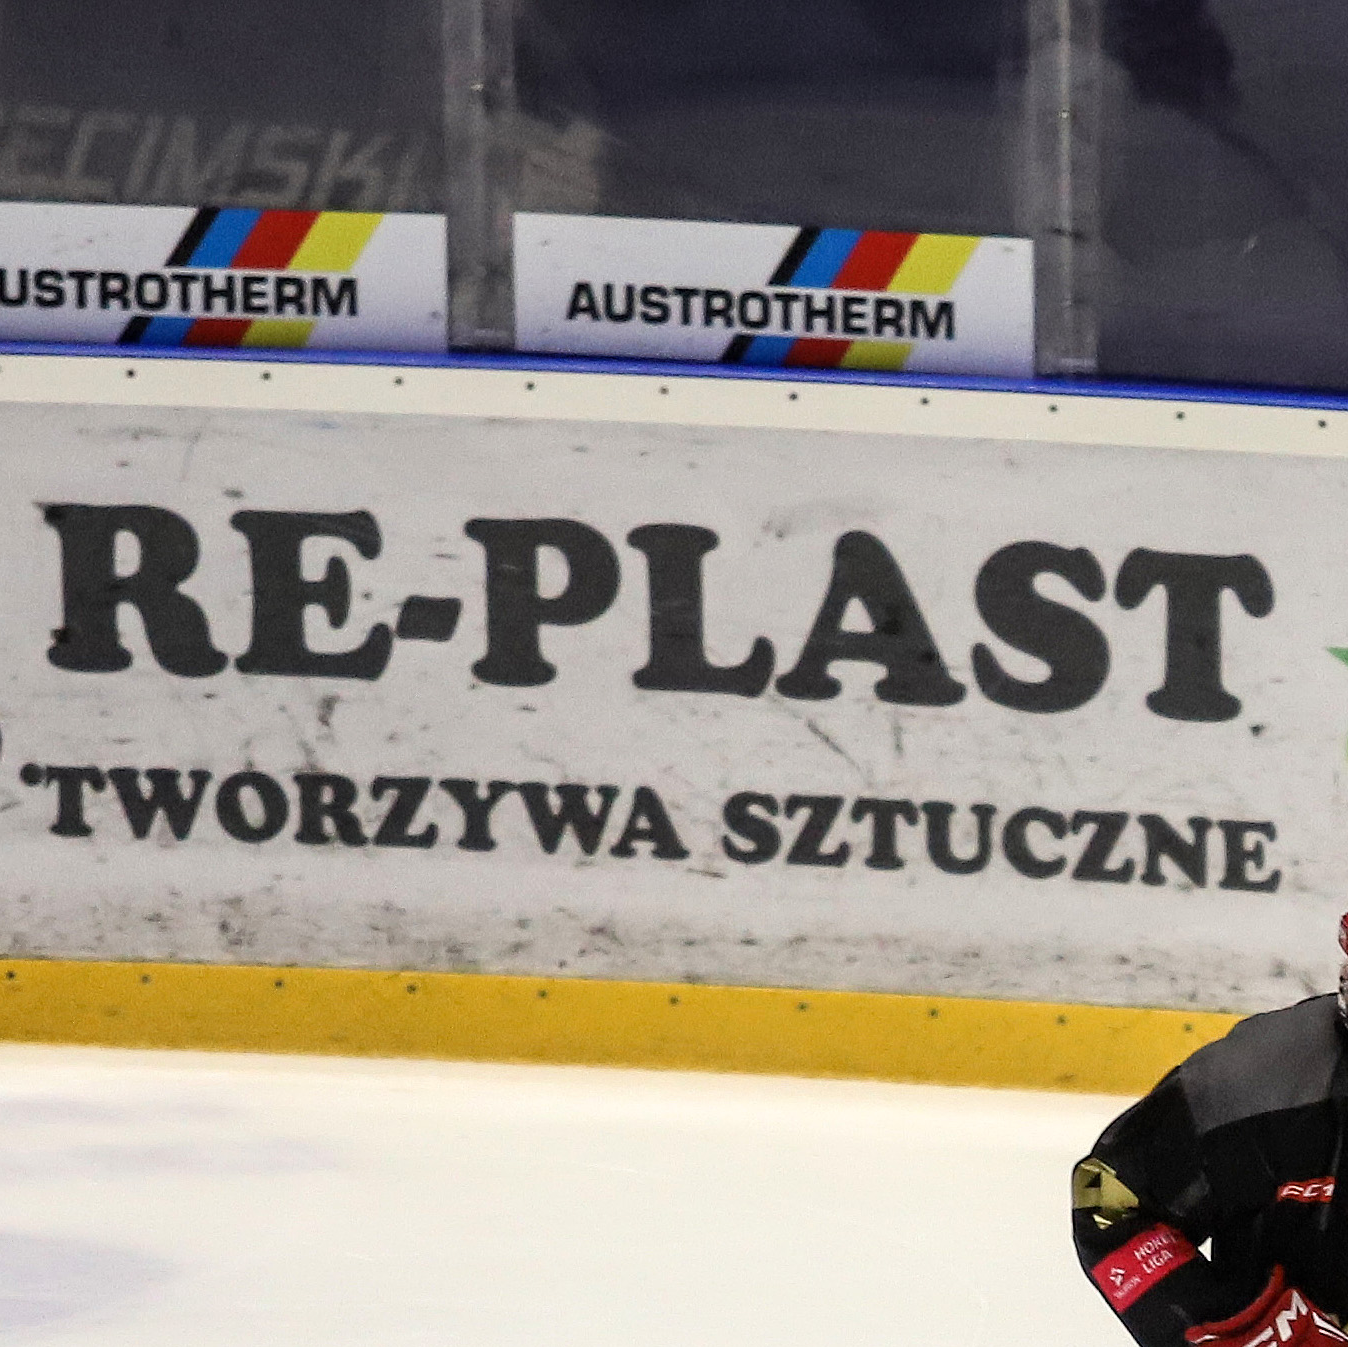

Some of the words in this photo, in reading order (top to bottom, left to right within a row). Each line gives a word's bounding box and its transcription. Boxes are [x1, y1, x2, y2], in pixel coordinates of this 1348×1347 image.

[566, 281, 955, 341] AUSTROTHERM
[41, 501, 1275, 723] RE-PLAST
[43, 764, 690, 861] TWORZYWA
[721, 790, 1281, 893] SZTUCZNE
[1141, 1249, 1174, 1275] LIGA
